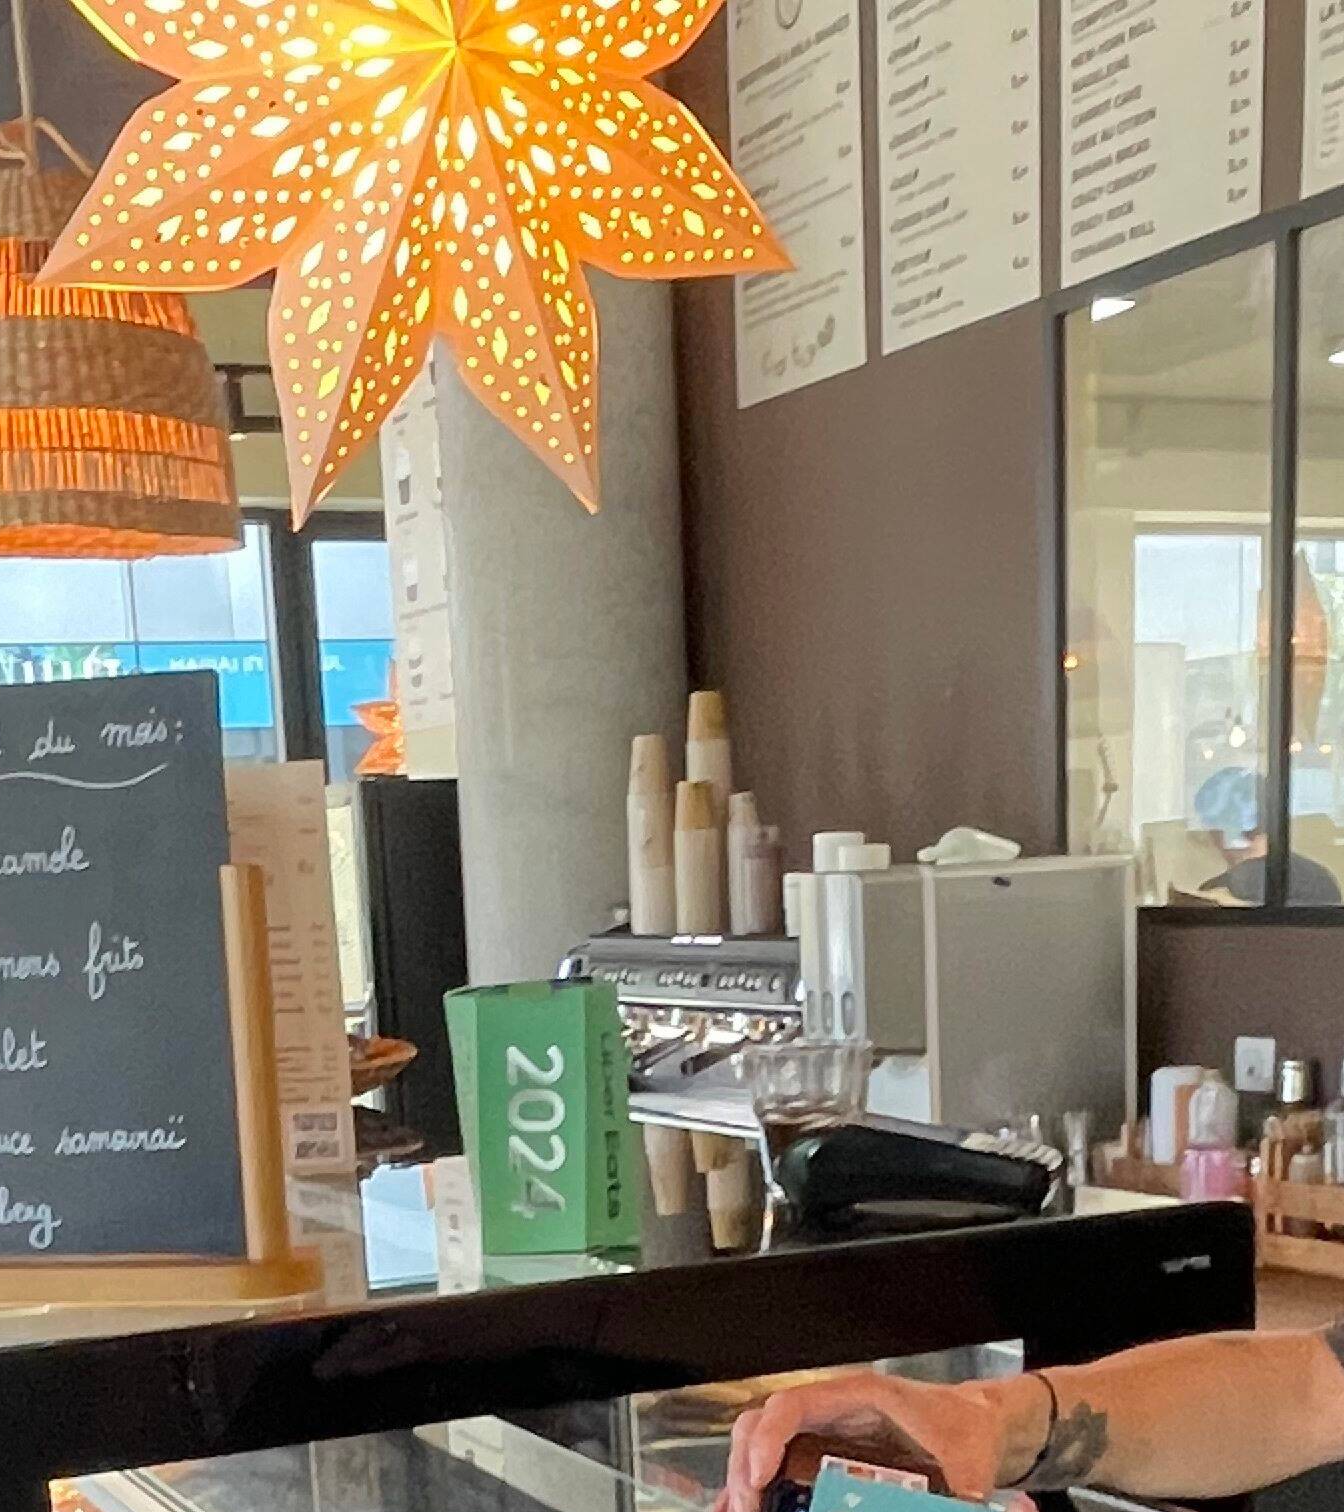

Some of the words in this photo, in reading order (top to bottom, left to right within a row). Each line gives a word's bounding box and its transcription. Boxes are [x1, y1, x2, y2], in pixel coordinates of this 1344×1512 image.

[28, 716, 77, 760] du
[82, 920, 144, 1001] frits
[506, 1044, 567, 1219] 2024
